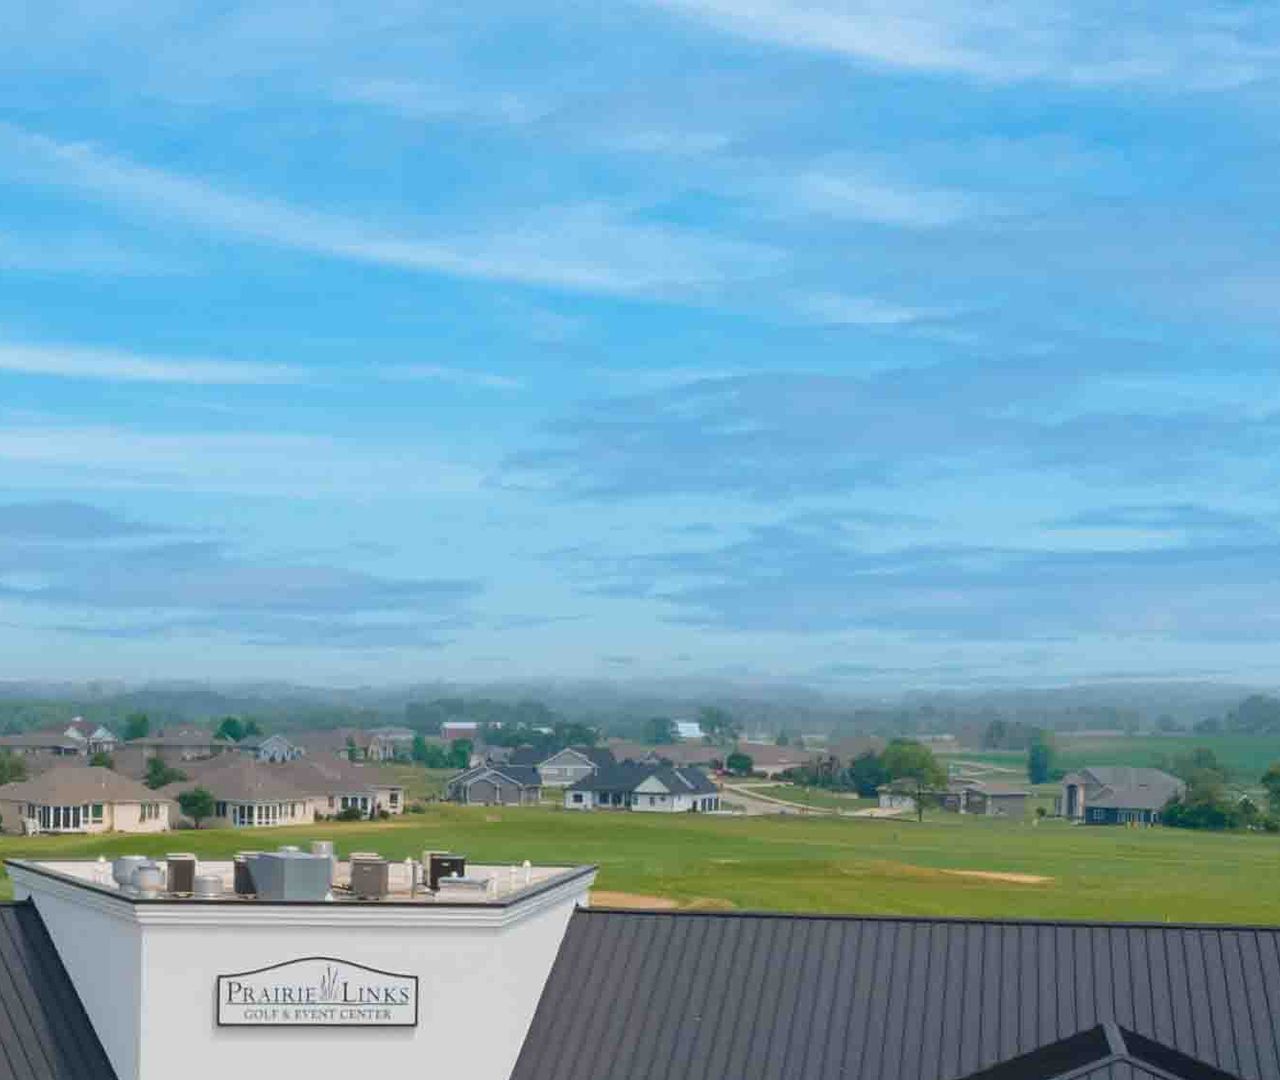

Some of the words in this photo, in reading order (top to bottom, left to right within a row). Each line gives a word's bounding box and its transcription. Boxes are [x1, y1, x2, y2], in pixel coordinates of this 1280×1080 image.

[227, 981, 318, 1003] PRAIRIE
[343, 982, 410, 1003] LINKS
[244, 1009, 277, 1020] GOLF
[295, 1009, 334, 1020] EVENT
[340, 1009, 391, 1020] CENTER
